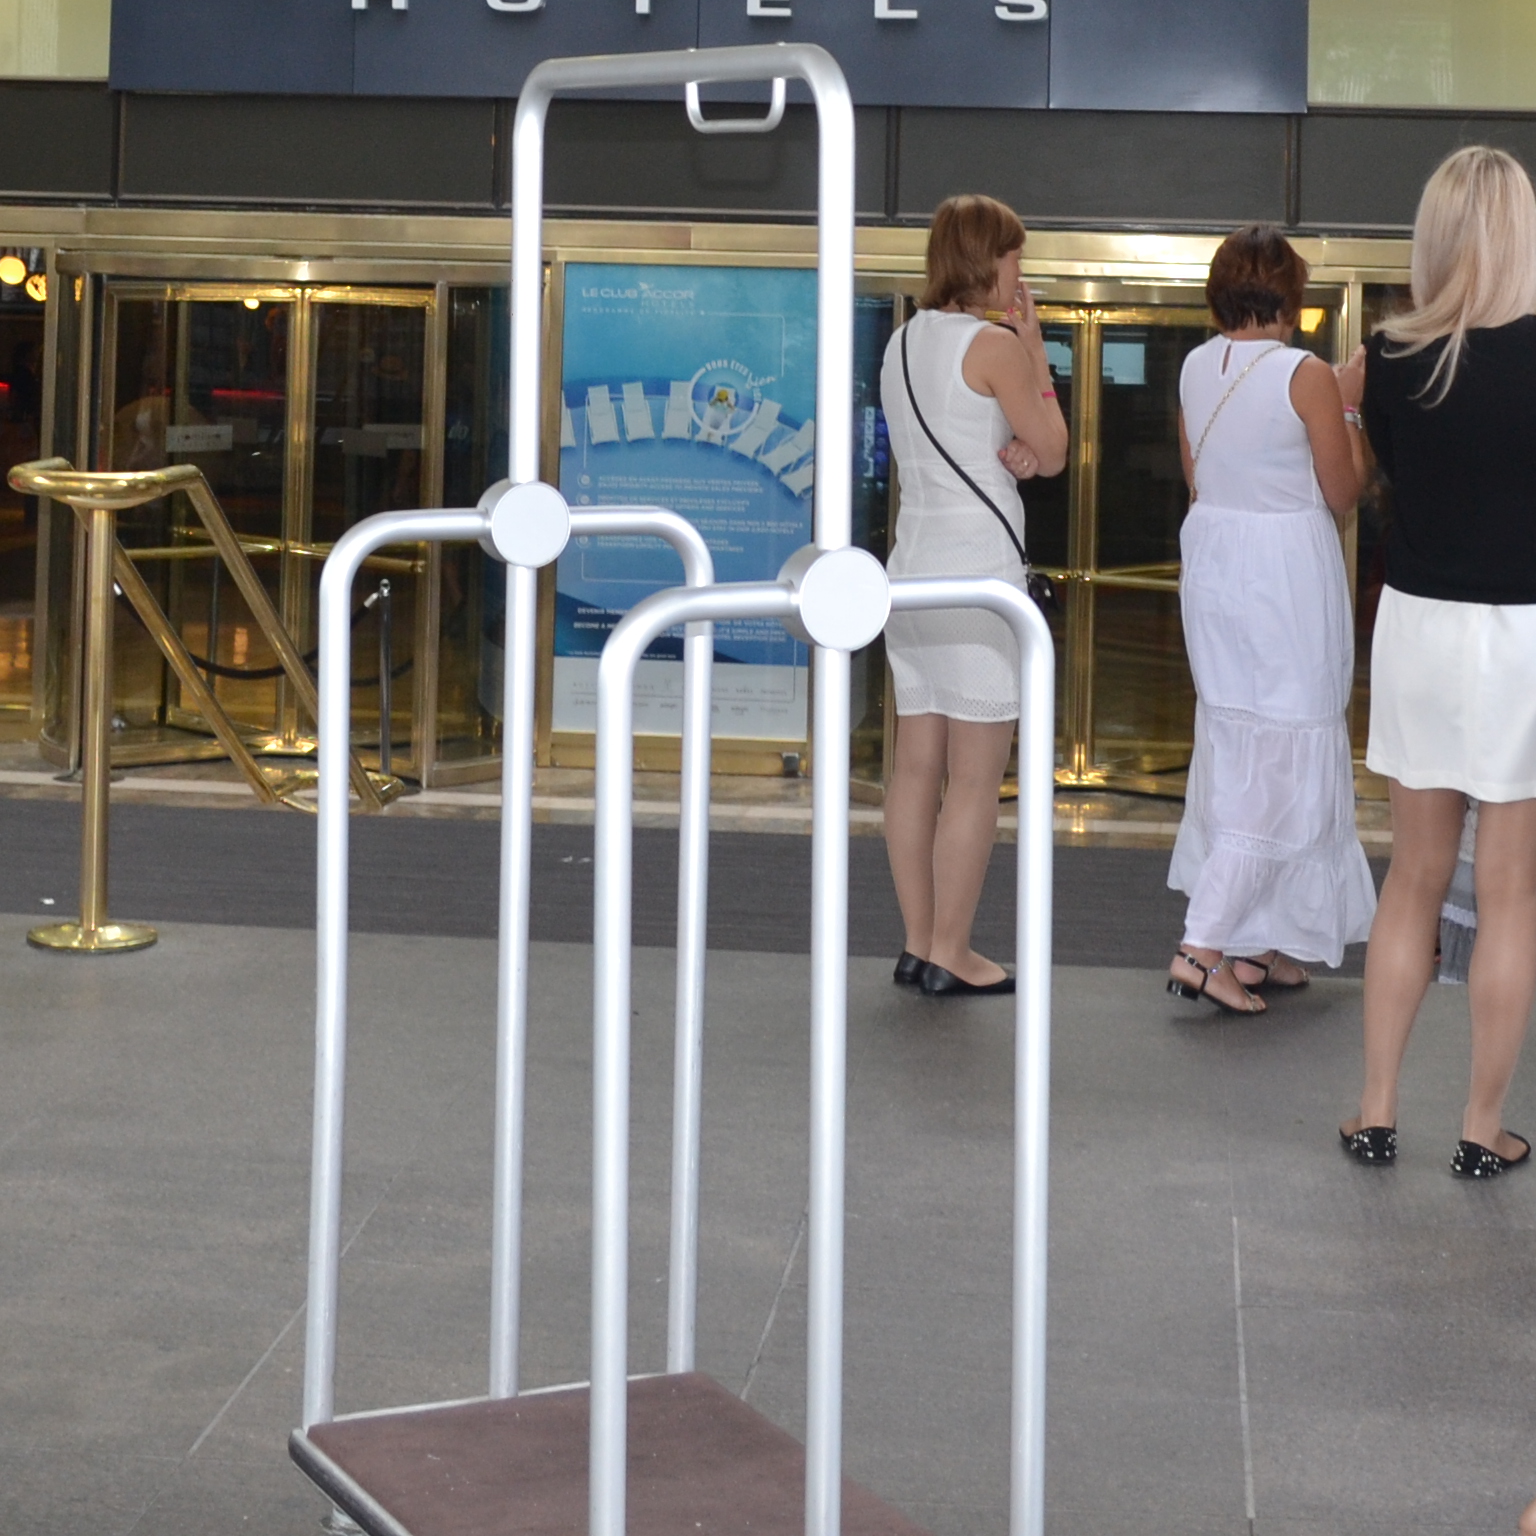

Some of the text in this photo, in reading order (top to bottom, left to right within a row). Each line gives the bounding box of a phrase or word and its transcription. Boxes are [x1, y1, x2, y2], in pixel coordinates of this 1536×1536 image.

[581, 287, 695, 301] LE CLUB ACCOR
